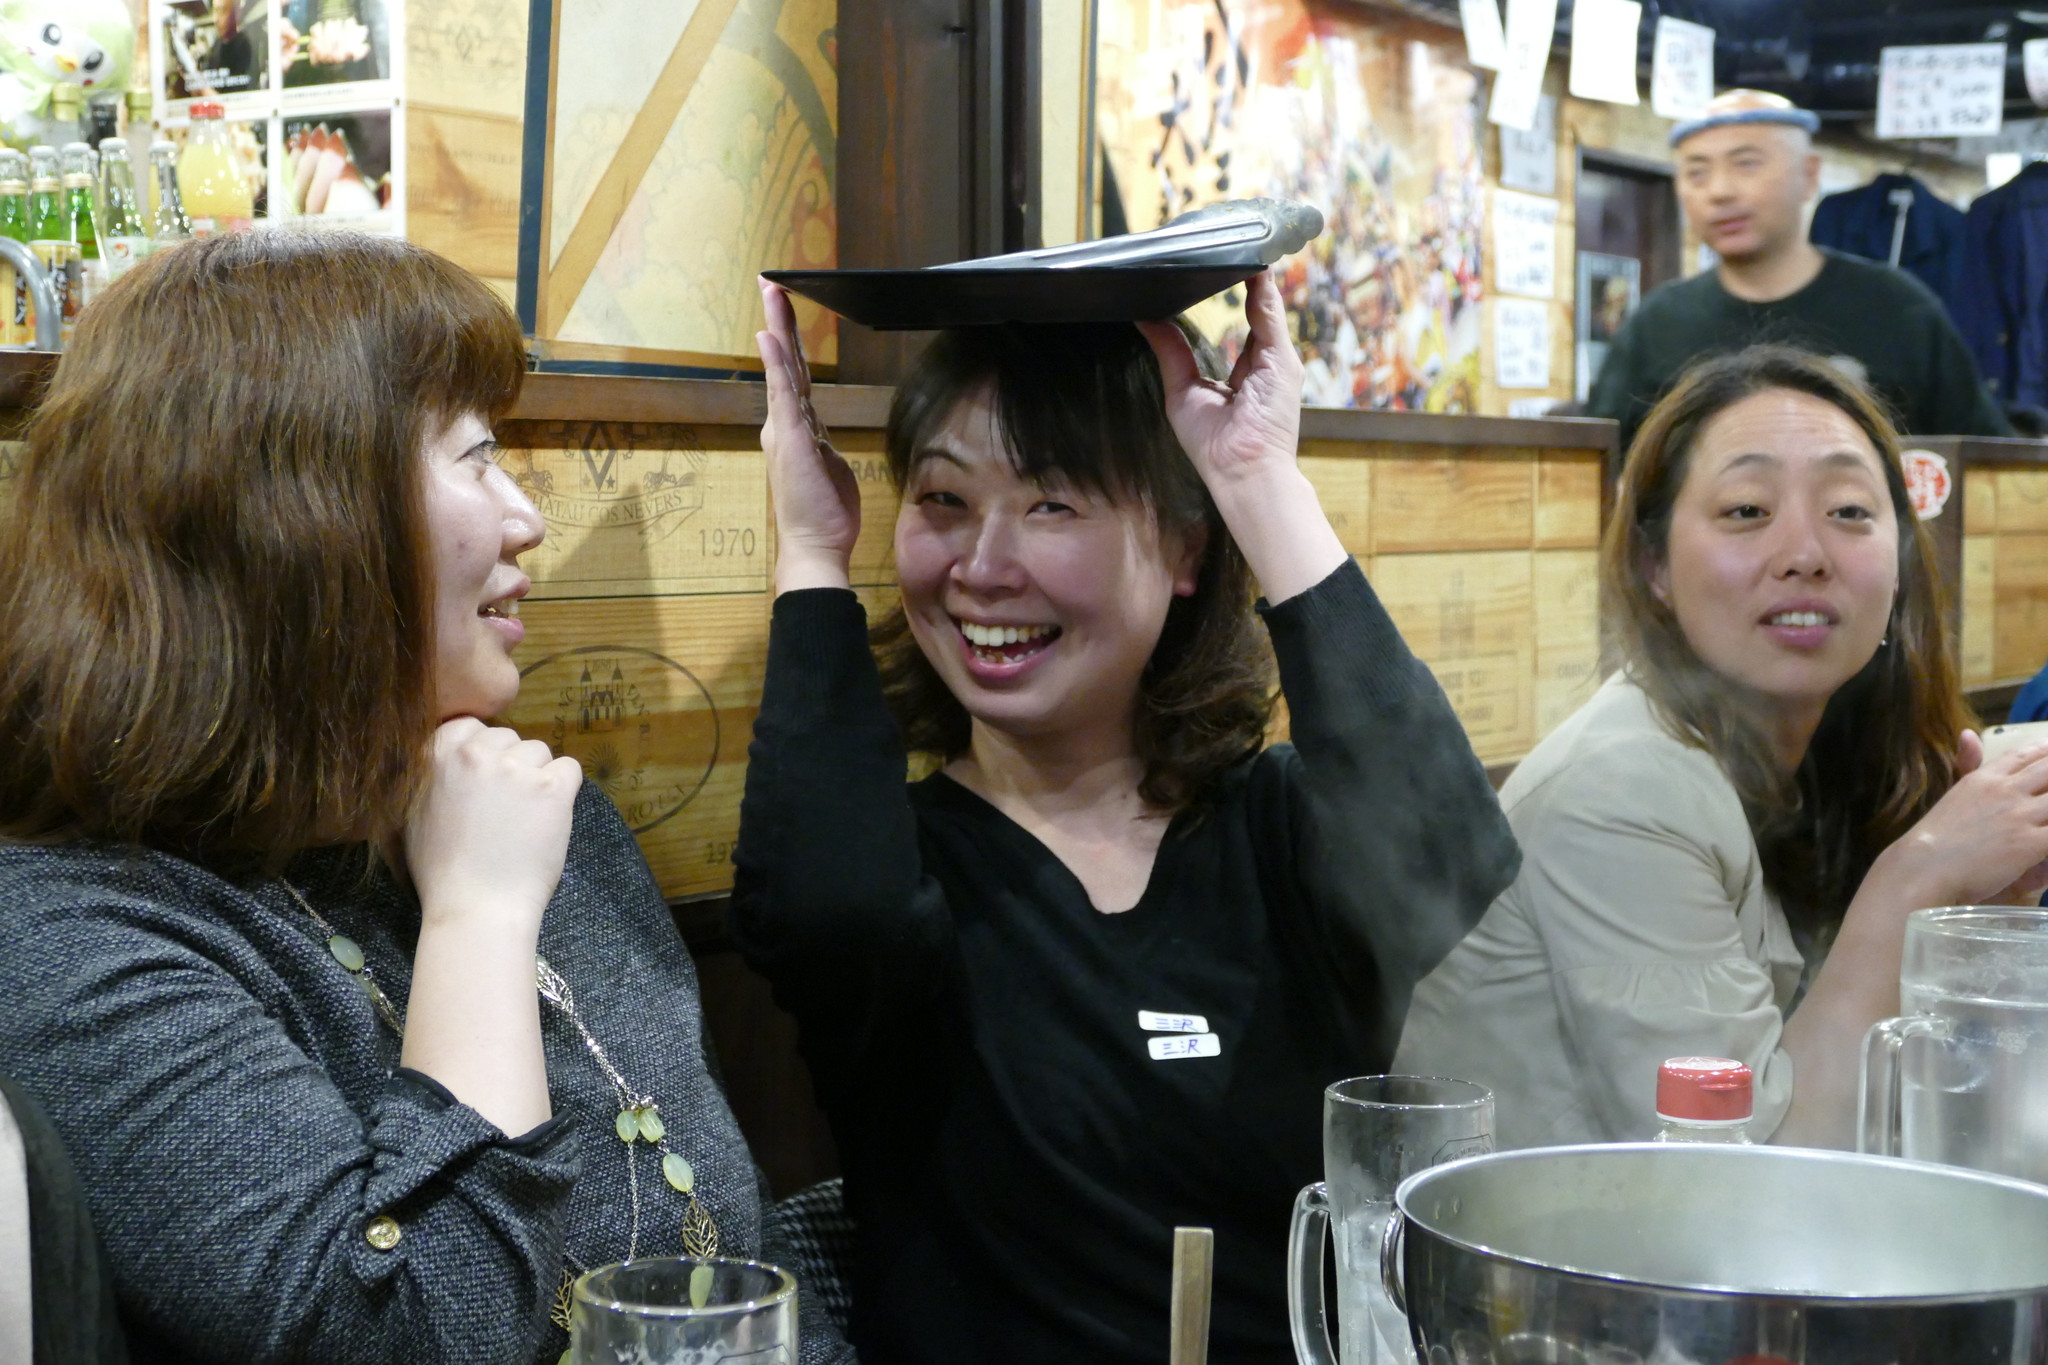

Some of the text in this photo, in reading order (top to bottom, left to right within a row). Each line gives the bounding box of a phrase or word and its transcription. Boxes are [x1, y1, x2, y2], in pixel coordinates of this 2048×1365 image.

[588, 504, 618, 523] COS
[622, 489, 683, 521] NEVERS
[698, 528, 756, 558] 1970
